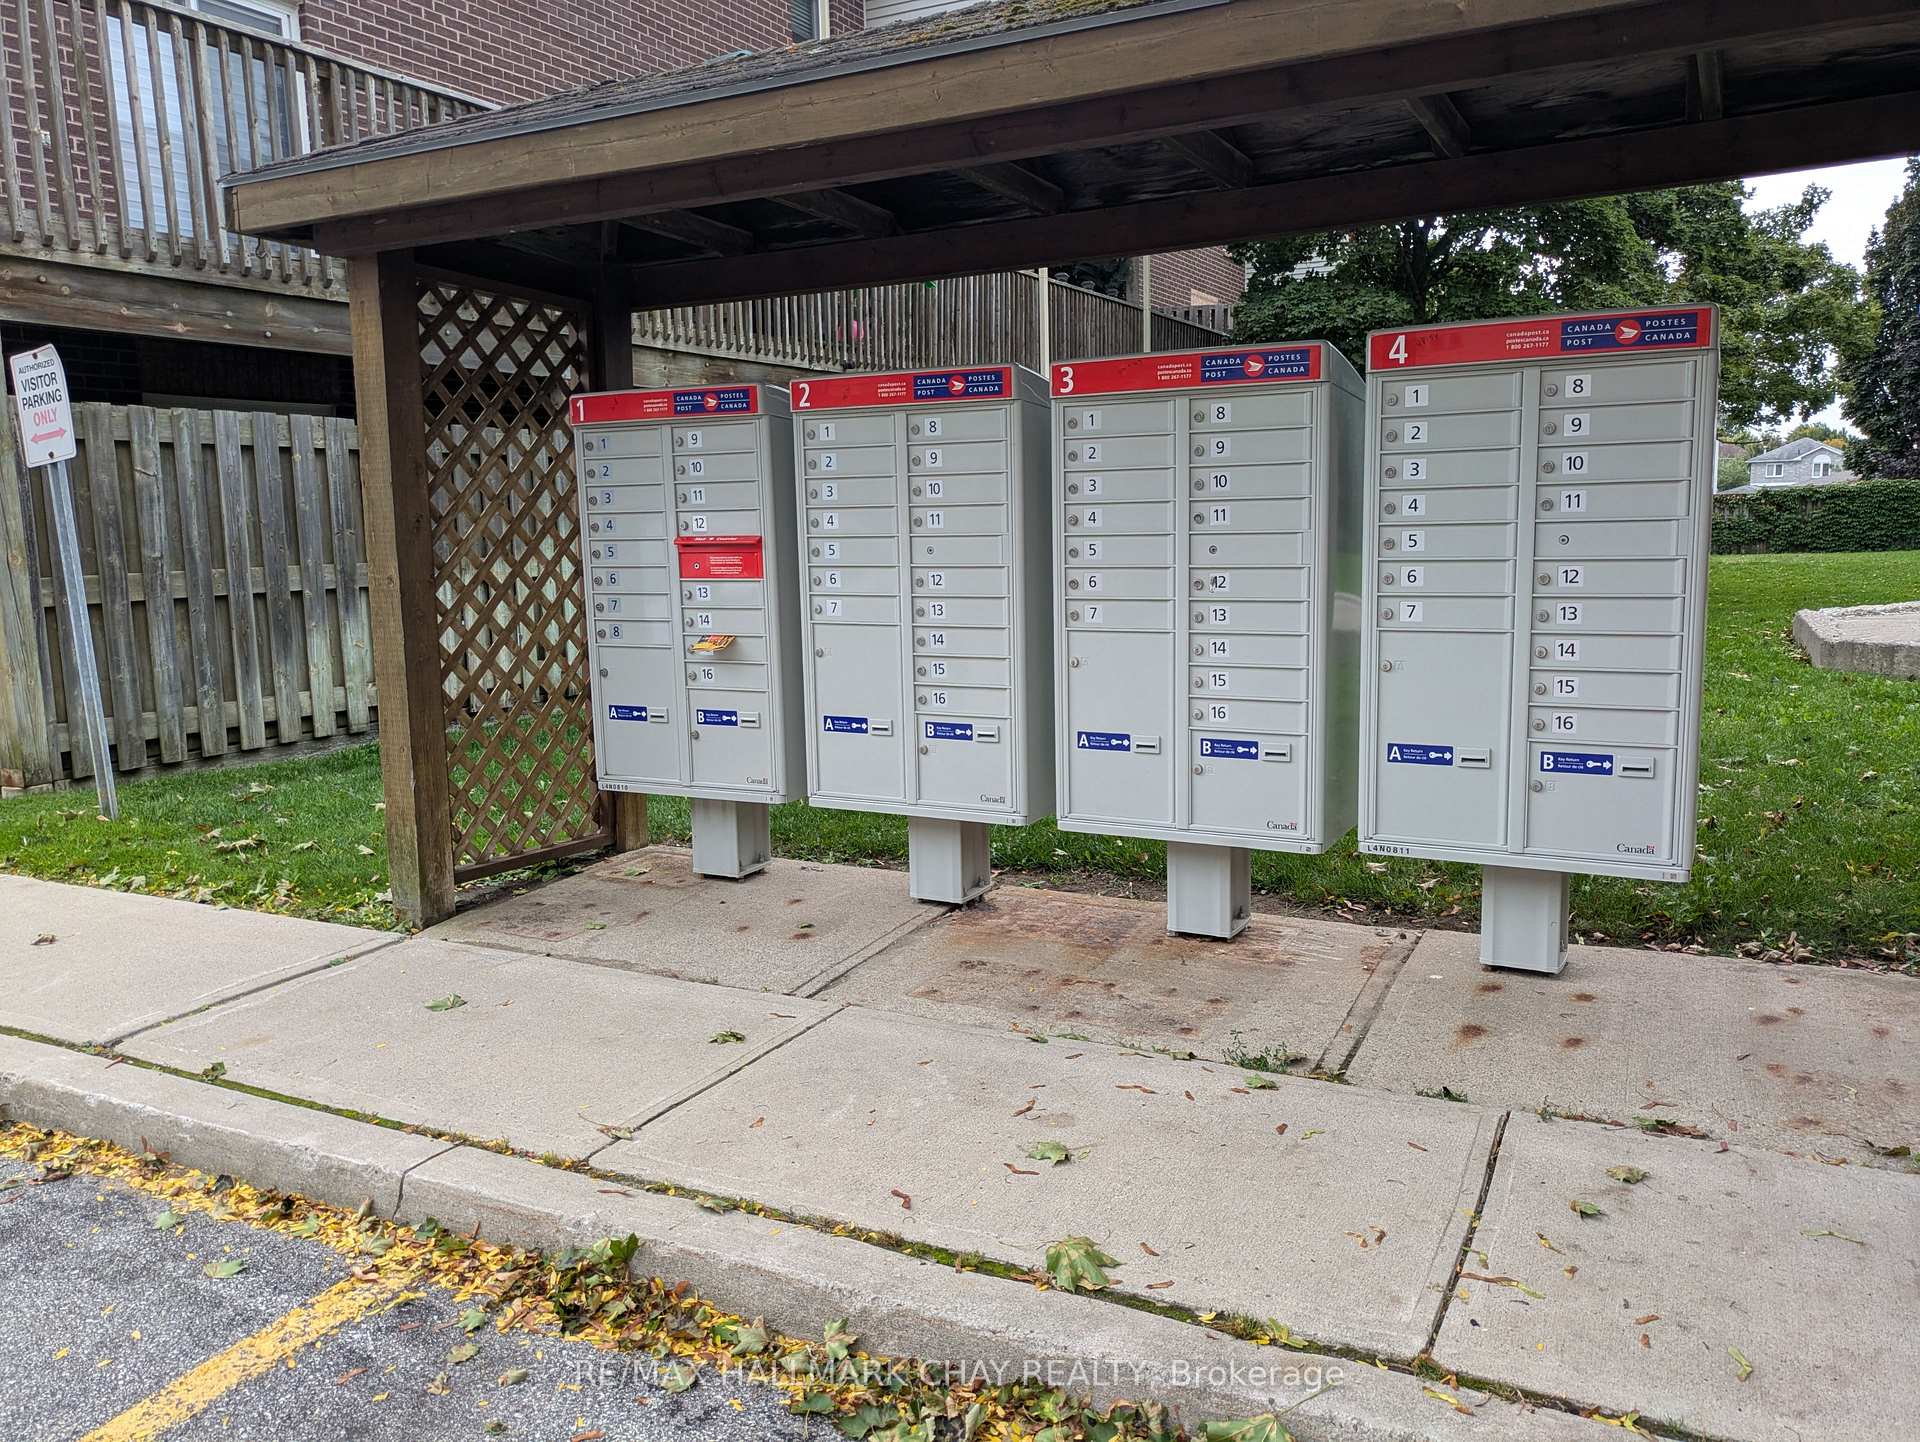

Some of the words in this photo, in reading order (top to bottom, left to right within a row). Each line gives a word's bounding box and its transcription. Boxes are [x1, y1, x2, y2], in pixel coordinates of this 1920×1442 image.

[1567, 323, 1612, 332] CANADA
[1646, 318, 1686, 327] POSTES
[1506, 329, 1549, 338] canadapost.ca
[1645, 331, 1691, 342] CANADA
[1567, 338, 1593, 346] POST
[1389, 335, 1408, 364] 4
[1269, 353, 1301, 361] POSTES
[19, 359, 55, 374] AUTHORIZED
[1269, 366, 1305, 375] CANADA
[21, 372, 58, 392] VISITOR
[1060, 367, 1074, 393] 3
[1573, 379, 1584, 393] 8
[799, 383, 810, 407] 2
[969, 385, 999, 393] CANADA
[22, 389, 62, 410] PARKING
[1413, 390, 1420, 403] 1
[577, 400, 585, 421] 1
[1216, 407, 1225, 420] 8
[33, 408, 58, 426] ONLY
[1088, 414, 1094, 426] 1
[929, 421, 937, 433] 8
[1571, 418, 1582, 432] 9
[825, 427, 830, 437] 1
[1411, 426, 1421, 440] 2
[601, 438, 606, 449] 1
[691, 434, 698, 444] 9
[1088, 447, 1096, 459] 2
[1216, 441, 1225, 454] 9
[826, 457, 832, 468] 2
[930, 452, 937, 464] 9
[1566, 456, 1584, 470] 10
[603, 466, 609, 477] 2
[692, 462, 702, 473] 10
[1410, 462, 1419, 476] 3
[1089, 480, 1096, 492] 3
[1213, 475, 1227, 487] 10
[827, 486, 833, 497] 3
[929, 484, 940, 494] 10
[605, 493, 611, 503] 3
[693, 490, 702, 501] 11
[1565, 494, 1581, 508] 11
[1408, 499, 1419, 512] 4
[827, 515, 834, 526] 4
[930, 514, 940, 525] 11
[1088, 512, 1096, 524] 4
[1213, 509, 1226, 521] 11
[606, 520, 613, 530] 4
[695, 518, 704, 528] 12
[1408, 534, 1418, 548] 5
[608, 547, 614, 557] 5
[829, 544, 835, 555] 5
[1089, 544, 1096, 556] 5
[610, 574, 616, 584] 6
[830, 574, 836, 585] 6
[931, 575, 942, 586] 12
[1089, 576, 1097, 588] 6
[1213, 576, 1226, 588] 12
[1407, 569, 1417, 583] 6
[1562, 570, 1579, 583] 12
[698, 588, 708, 598] 13
[611, 600, 617, 610] 7
[831, 603, 837, 613] 7
[932, 604, 943, 615] 13
[1090, 608, 1097, 620] 7
[1213, 609, 1226, 621] 13
[1407, 605, 1416, 618] 7
[1560, 606, 1578, 621] 13
[699, 615, 709, 625] 14
[613, 626, 620, 637] 8
[932, 634, 944, 645] 14
[1212, 642, 1227, 654] 14
[1558, 643, 1576, 657] 14
[703, 669, 713, 679] 16
[933, 664, 945, 675] 15
[1212, 674, 1226, 686] 15
[1557, 680, 1575, 694] 15
[934, 693, 946, 704] 16
[610, 708, 617, 718] A
[698, 712, 704, 723] B
[1212, 707, 1226, 719] 16
[825, 719, 833, 730] A
[1556, 716, 1574, 729] 16
[927, 724, 934, 736] B
[1079, 734, 1088, 747] A
[1203, 741, 1211, 754] B
[1389, 746, 1401, 761] A
[1543, 755, 1553, 769] B
[1267, 820, 1297, 831] Canada
[1367, 845, 1411, 854] L4N0811
[1617, 843, 1655, 854] Canada
